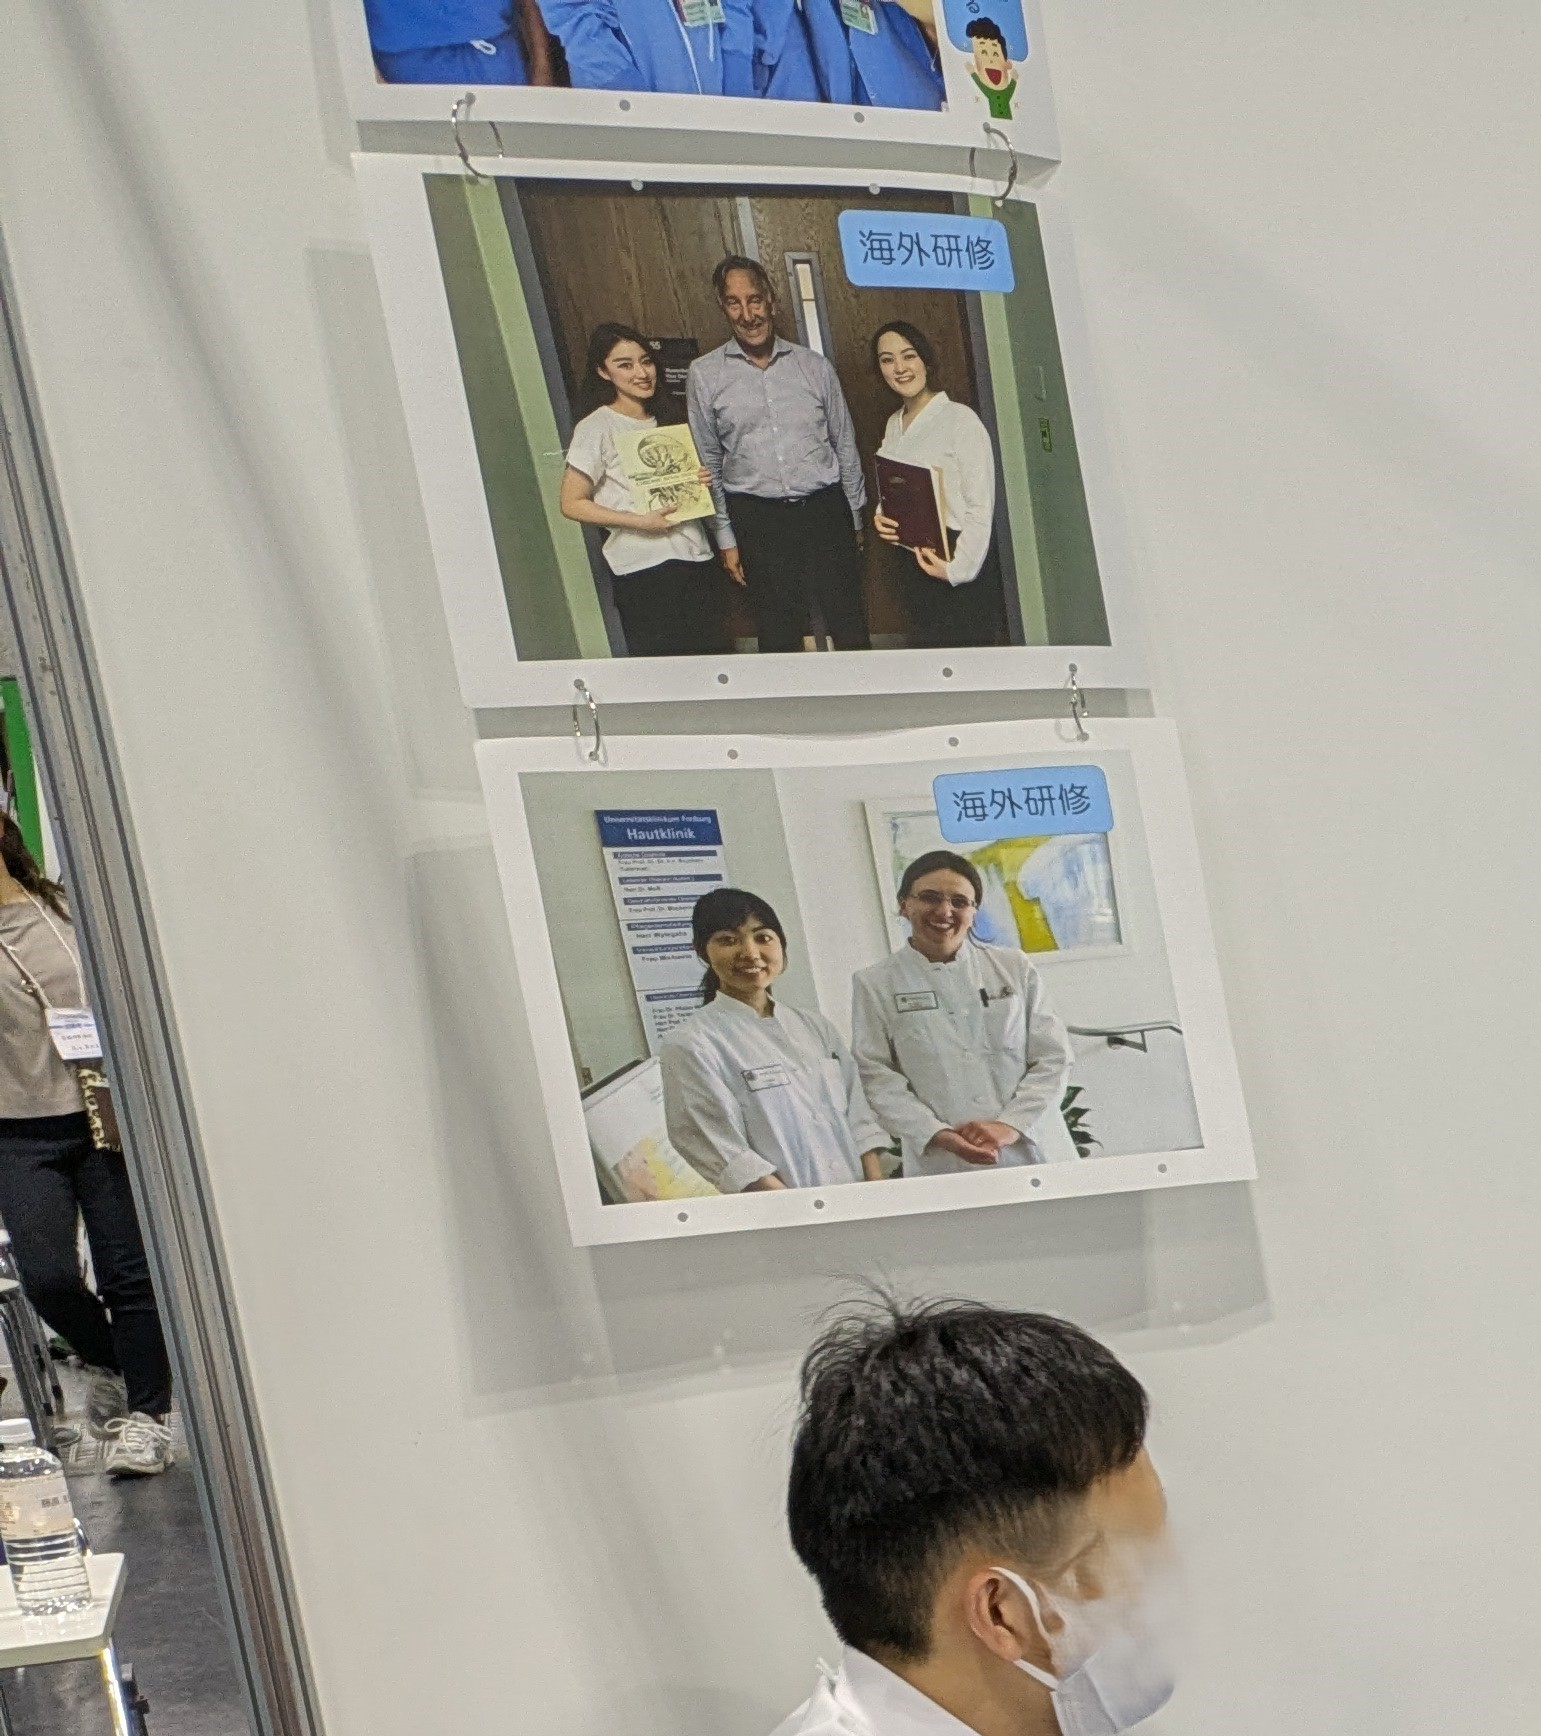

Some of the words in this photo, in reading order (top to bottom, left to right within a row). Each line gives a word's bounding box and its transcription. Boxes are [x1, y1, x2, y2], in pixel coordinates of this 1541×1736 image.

[859, 230, 995, 270] 海外研修
[953, 783, 1091, 823] 海外研修
[626, 828, 696, 840] Hautklinik
